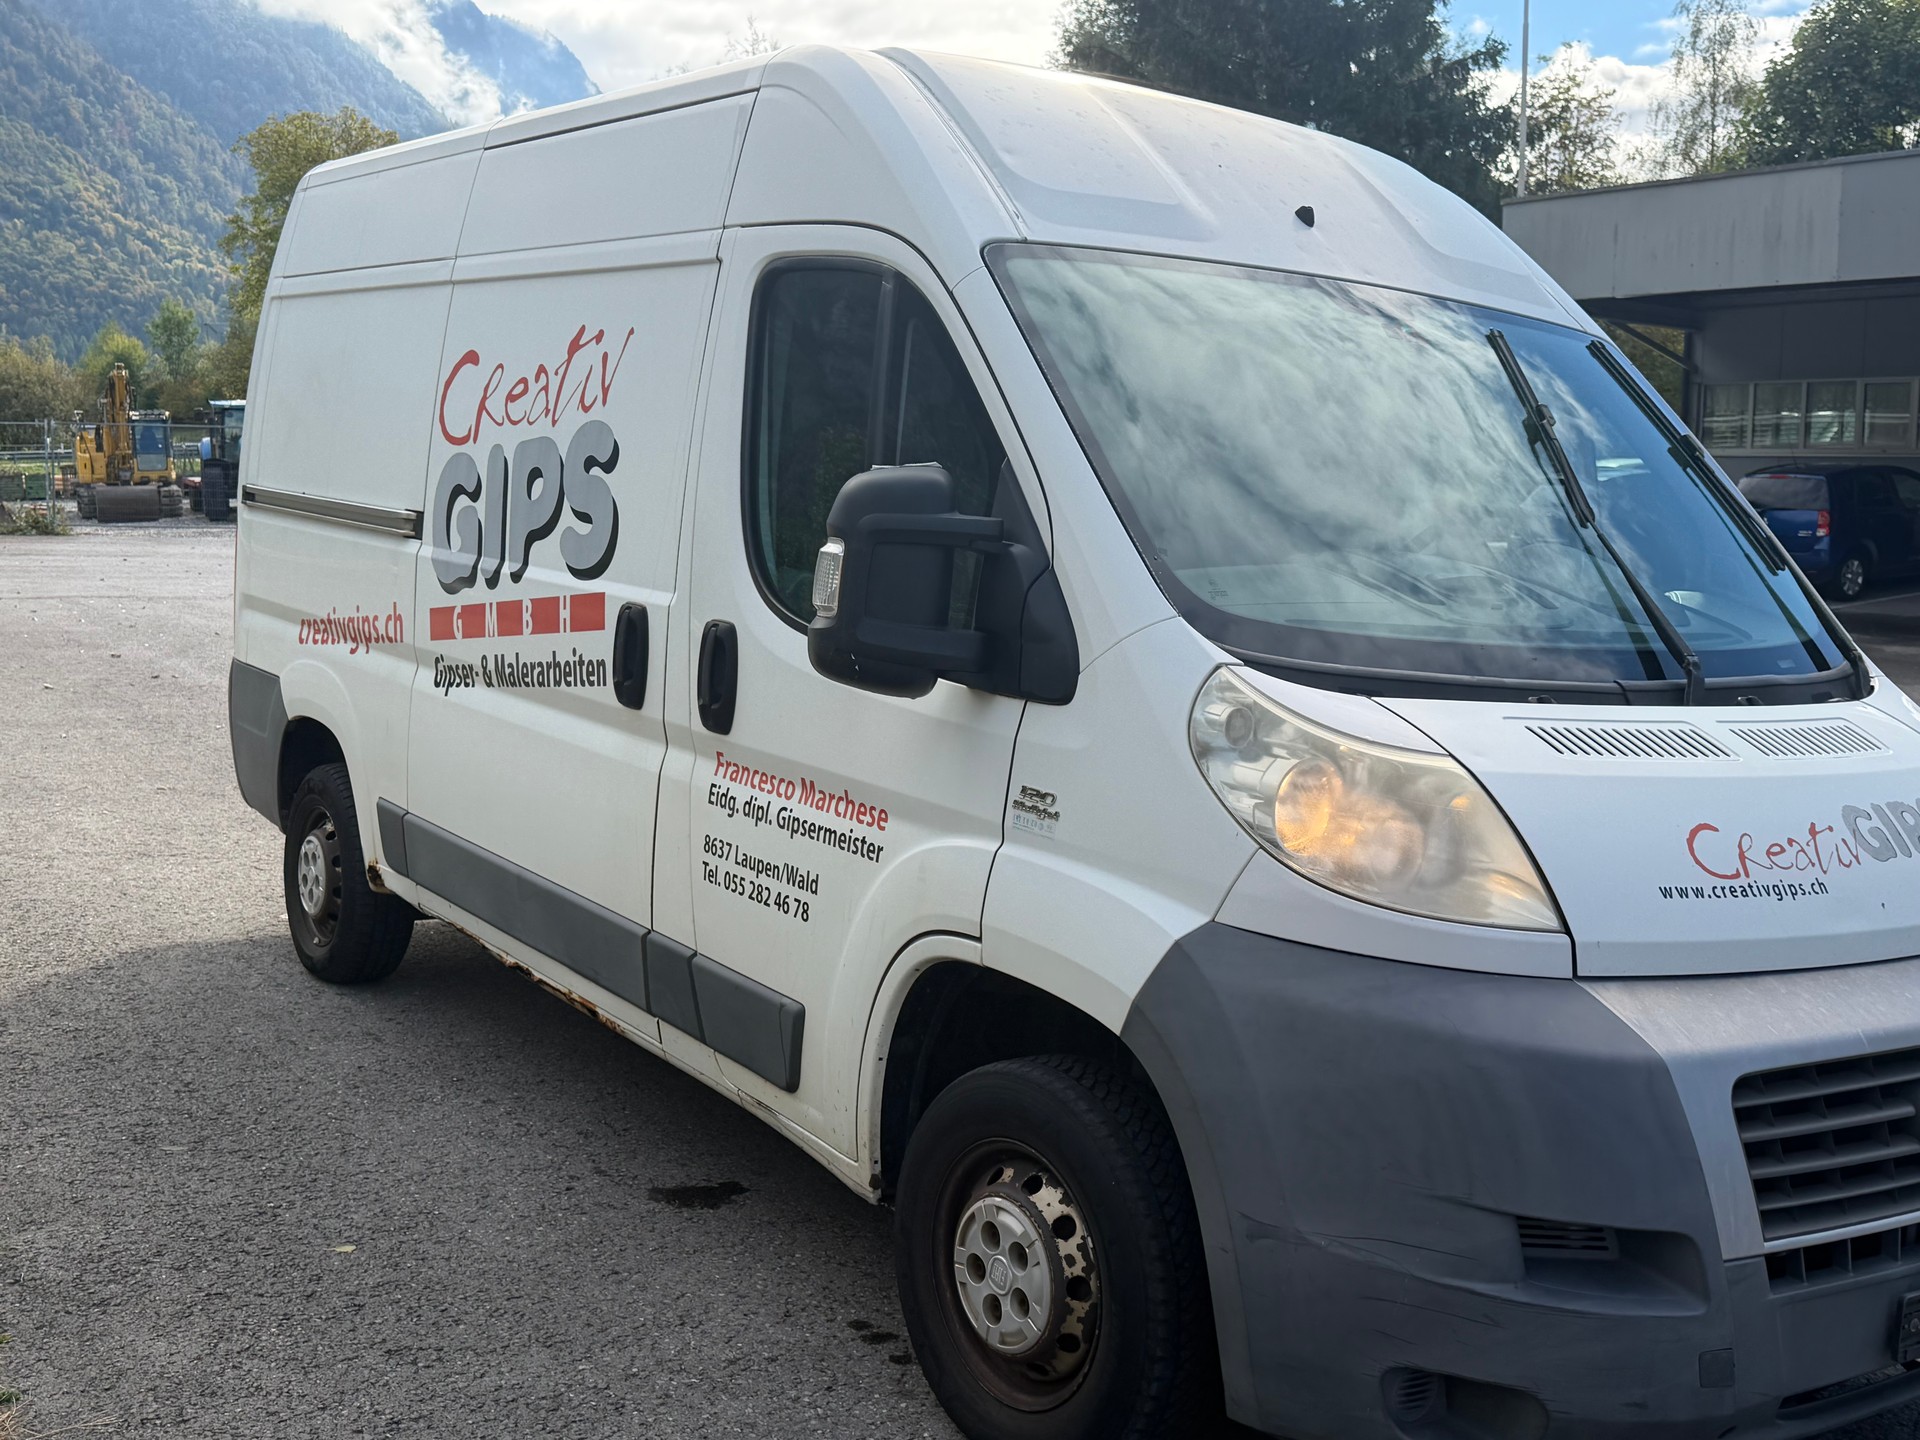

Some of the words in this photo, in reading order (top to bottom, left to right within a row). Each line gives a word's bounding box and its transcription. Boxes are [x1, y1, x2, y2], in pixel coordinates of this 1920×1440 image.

[432, 420, 620, 595] GIPS
[298, 601, 403, 655] creativgips.ch
[434, 654, 480, 697] Gipser-
[481, 654, 494, 688] &
[494, 647, 607, 688] Malerarbeiten
[714, 751, 796, 801] Francesco
[798, 777, 888, 831] Marchese
[707, 783, 740, 818] Eidg.
[742, 795, 773, 827] dipl.
[776, 807, 884, 863] Gipsermeister
[1841, 798, 1920, 862] GIP
[702, 861, 721, 886] Tel.
[723, 871, 746, 896] 055
[748, 880, 771, 907] 282
[773, 891, 790, 914] 46
[793, 898, 810, 922] 78
[703, 834, 733, 861] 8637
[734, 845, 820, 895] Laupen/Wald
[1658, 877, 1829, 901] www.creativgips.ch
